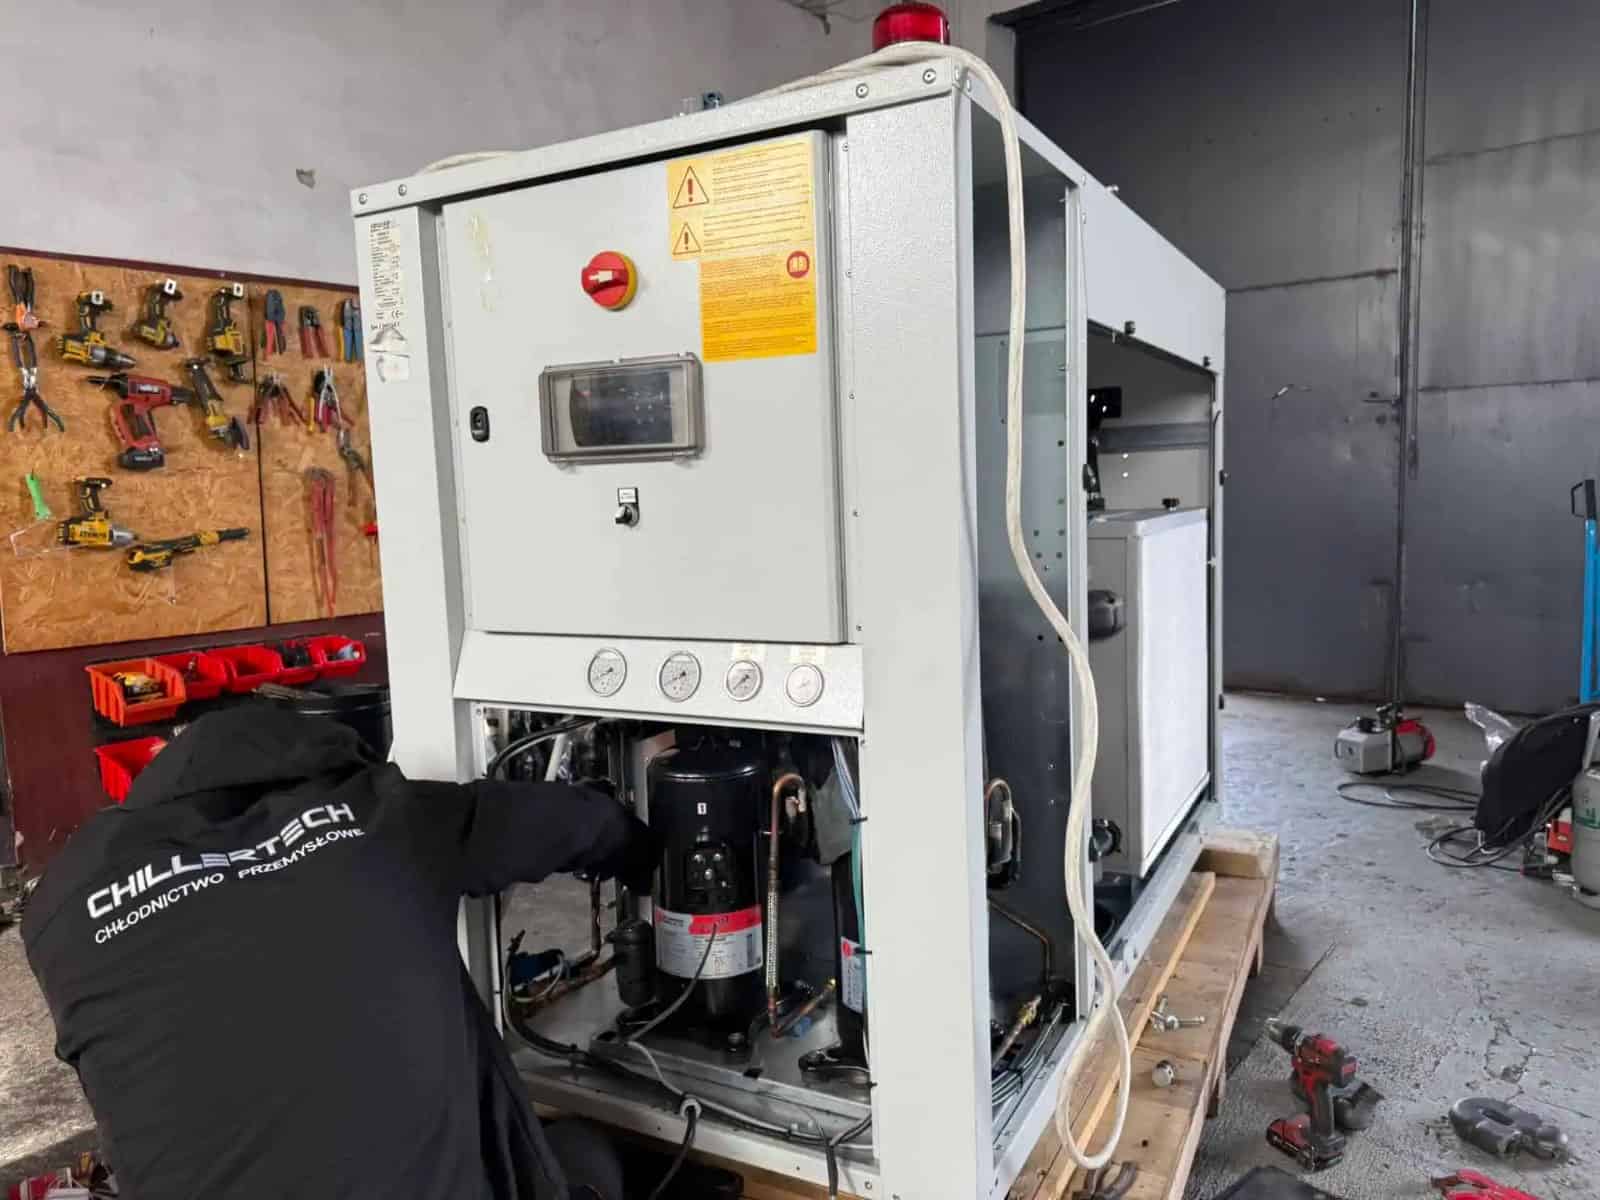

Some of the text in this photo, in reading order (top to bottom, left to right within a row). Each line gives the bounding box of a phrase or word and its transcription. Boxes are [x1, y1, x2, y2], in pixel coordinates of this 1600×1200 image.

[87, 803, 355, 919] CHILLERTECH
[95, 827, 365, 944] CHŁODNICTWO PRZEMYSŁOWE
